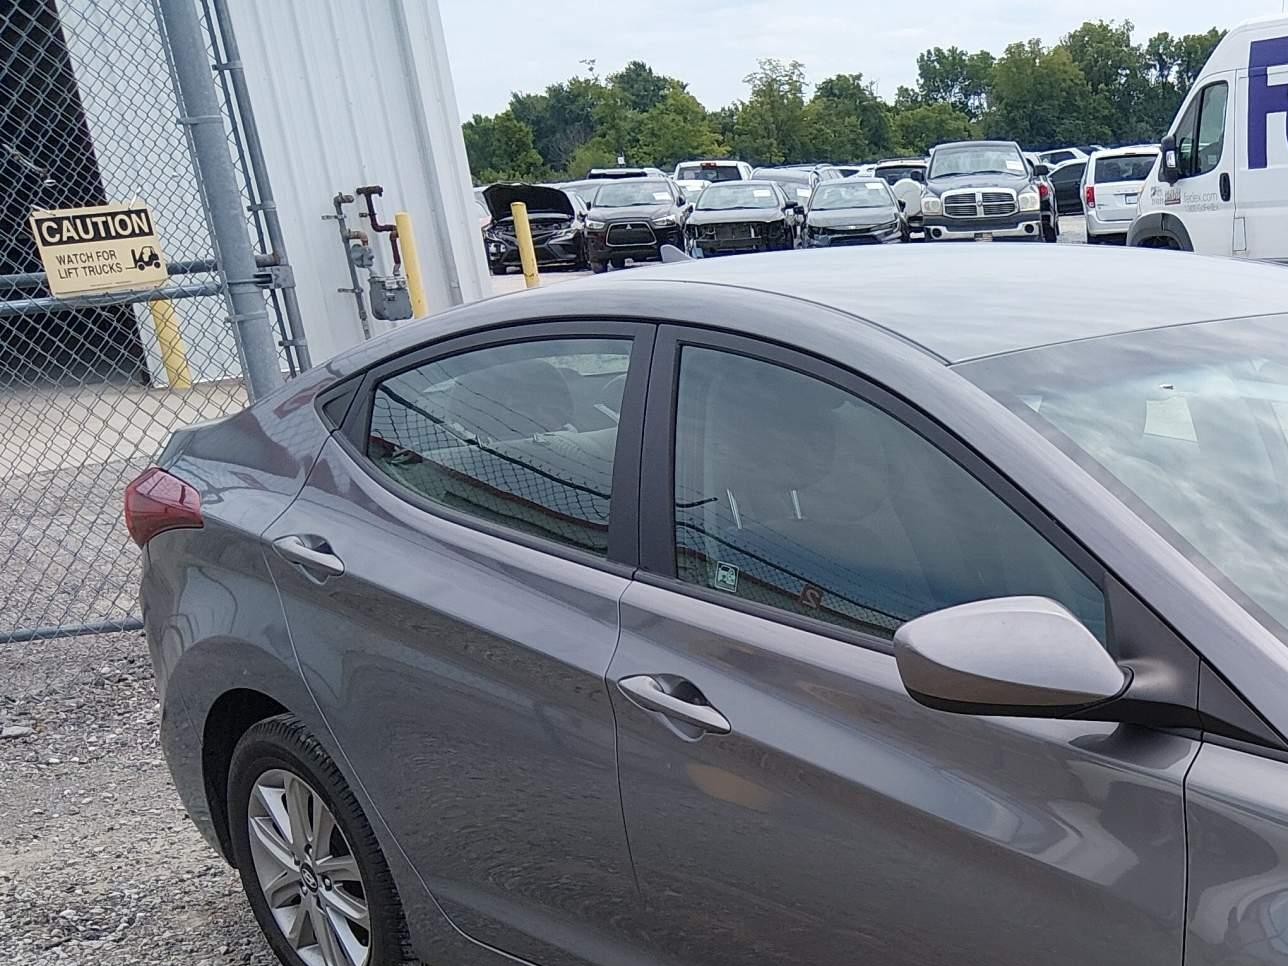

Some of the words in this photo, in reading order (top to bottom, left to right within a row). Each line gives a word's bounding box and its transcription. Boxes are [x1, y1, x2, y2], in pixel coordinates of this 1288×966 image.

[41, 212, 150, 243] CAUTION
[56, 252, 93, 265] WATCH
[96, 249, 117, 261] FOR
[57, 267, 79, 279] LIFT
[81, 262, 123, 276] TRUCKS
